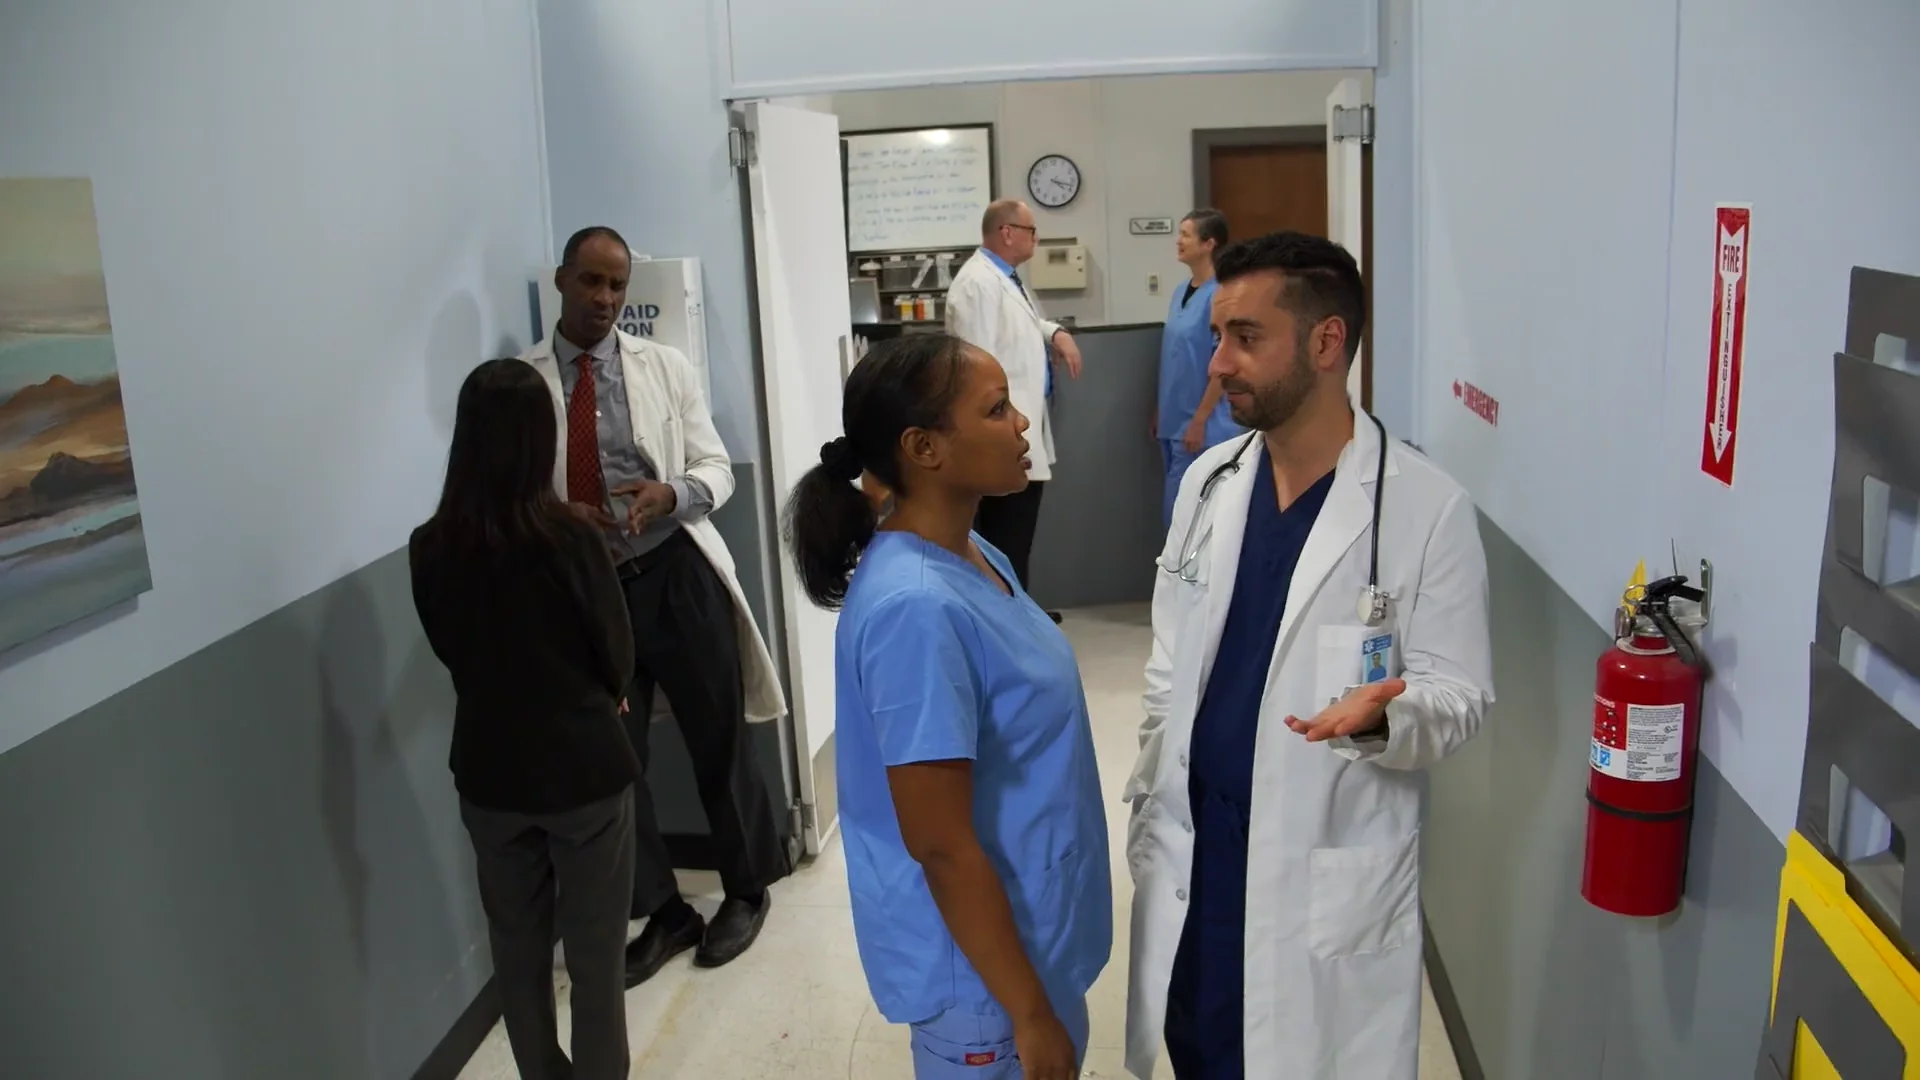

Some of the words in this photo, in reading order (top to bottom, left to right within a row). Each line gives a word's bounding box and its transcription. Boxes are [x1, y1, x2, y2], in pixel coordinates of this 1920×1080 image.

[1722, 244, 1740, 272] FIRE
[623, 304, 660, 319] AID
[1716, 283, 1733, 451] EXTINGUISHER
